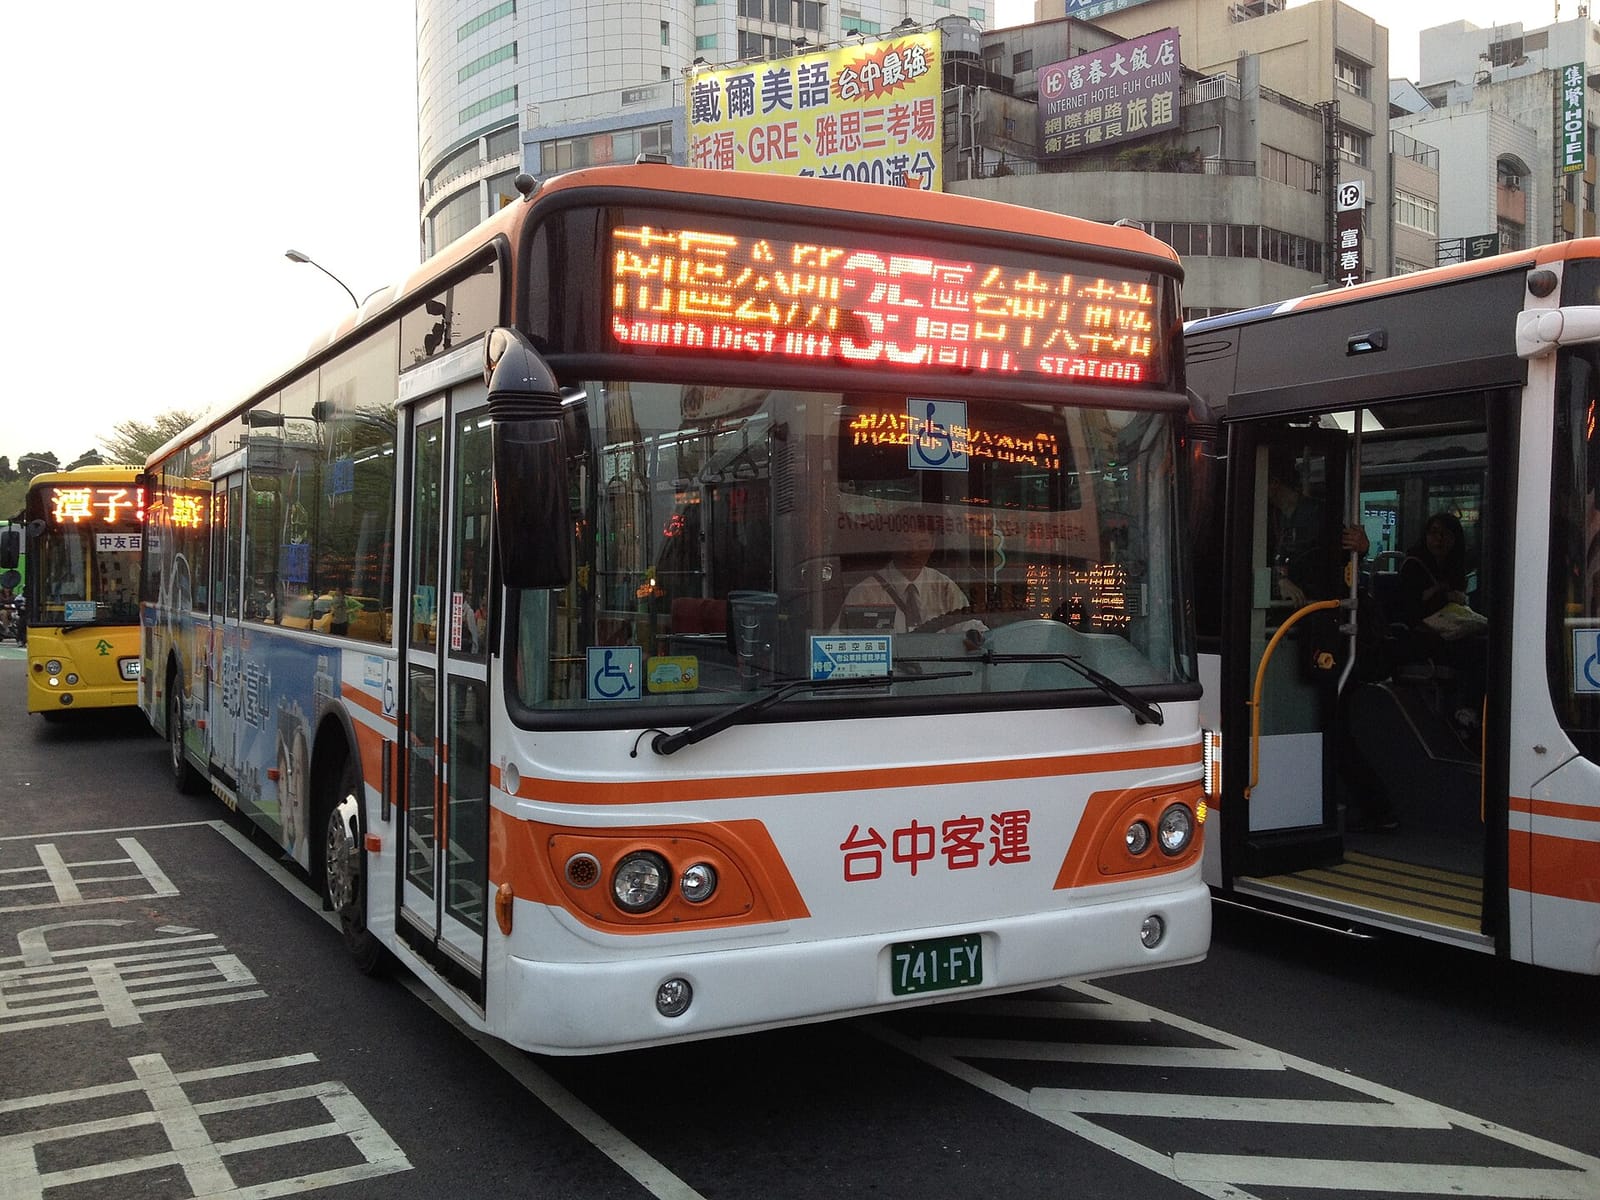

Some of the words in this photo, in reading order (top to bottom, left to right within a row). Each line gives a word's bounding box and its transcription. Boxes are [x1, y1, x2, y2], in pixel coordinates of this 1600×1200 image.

[838, 44, 929, 100] 台中最強
[1067, 39, 1175, 91] 富春大飯店
[690, 61, 830, 125] 戴爾美語
[1048, 93, 1088, 115] INTERNET
[1091, 85, 1119, 105] HOTEL
[1122, 80, 1141, 96] FUH
[1144, 71, 1171, 89] CHUN
[1127, 91, 1173, 133] 旅館
[1565, 109, 1582, 165] HOTEL
[840, 809, 1032, 883] 台中客運
[896, 944, 979, 987] 741-FY
